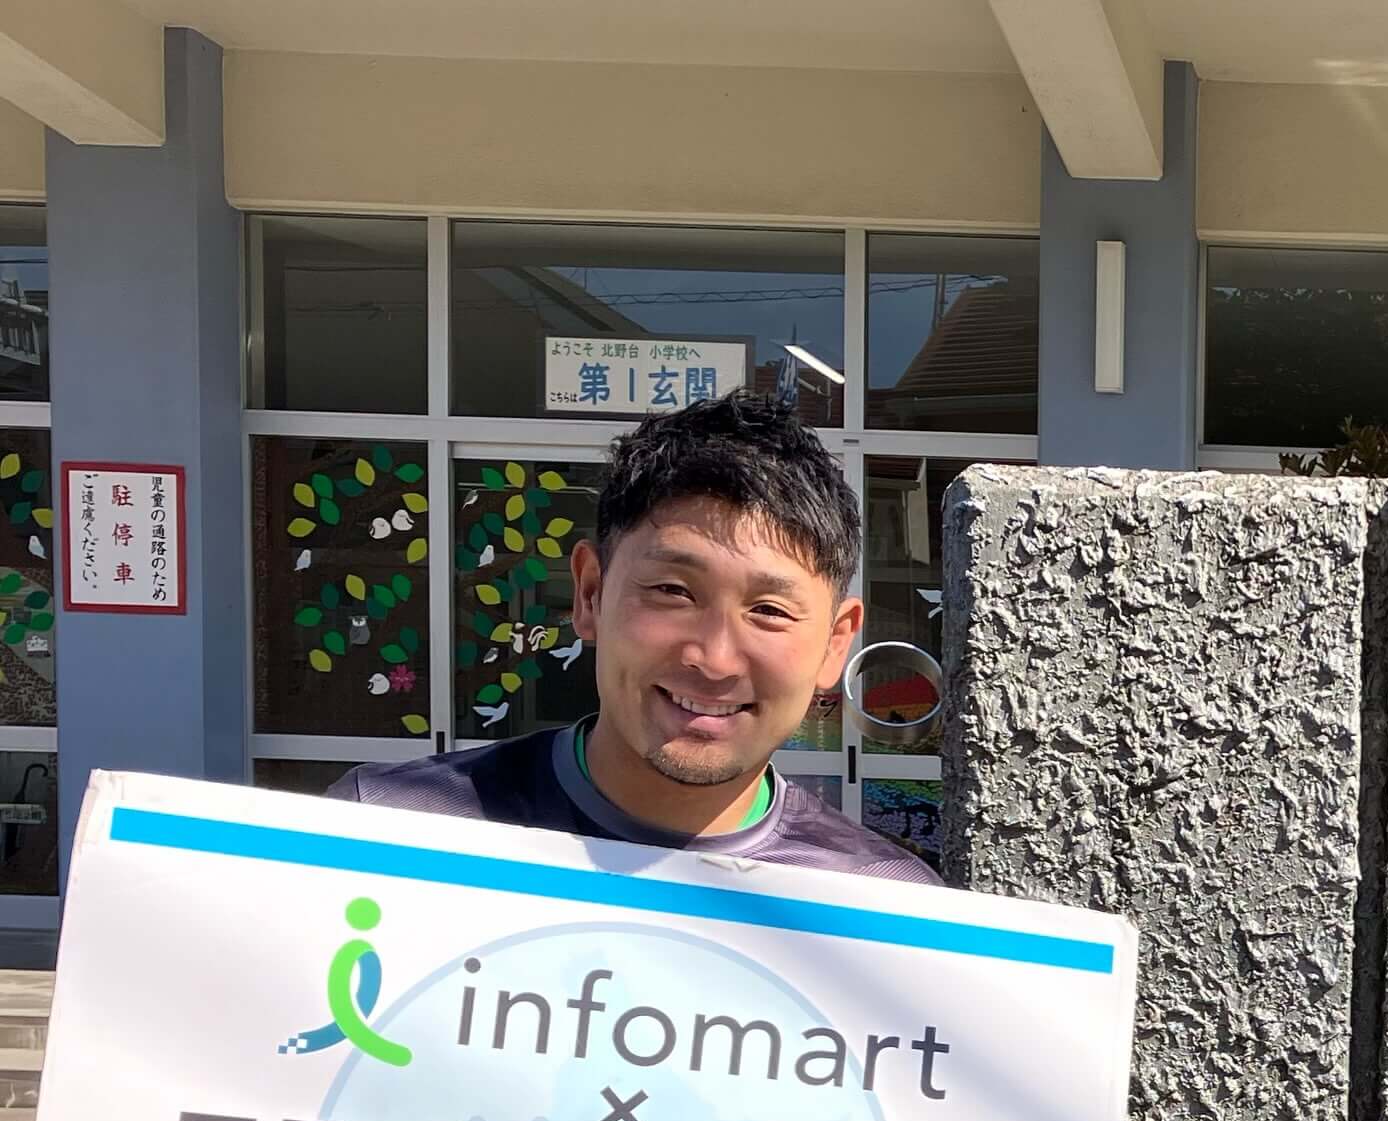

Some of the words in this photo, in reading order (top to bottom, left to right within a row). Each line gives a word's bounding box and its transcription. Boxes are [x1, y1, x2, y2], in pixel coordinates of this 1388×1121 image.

[550, 391, 578, 403] こちらは
[551, 343, 593, 357] ようこそ
[601, 343, 640, 359] 北野台
[650, 344, 701, 361] 小学校へ
[111, 484, 135, 586] 駐停車
[150, 476, 167, 602] 児童の通路のため
[456, 957, 951, 1101] infomart
